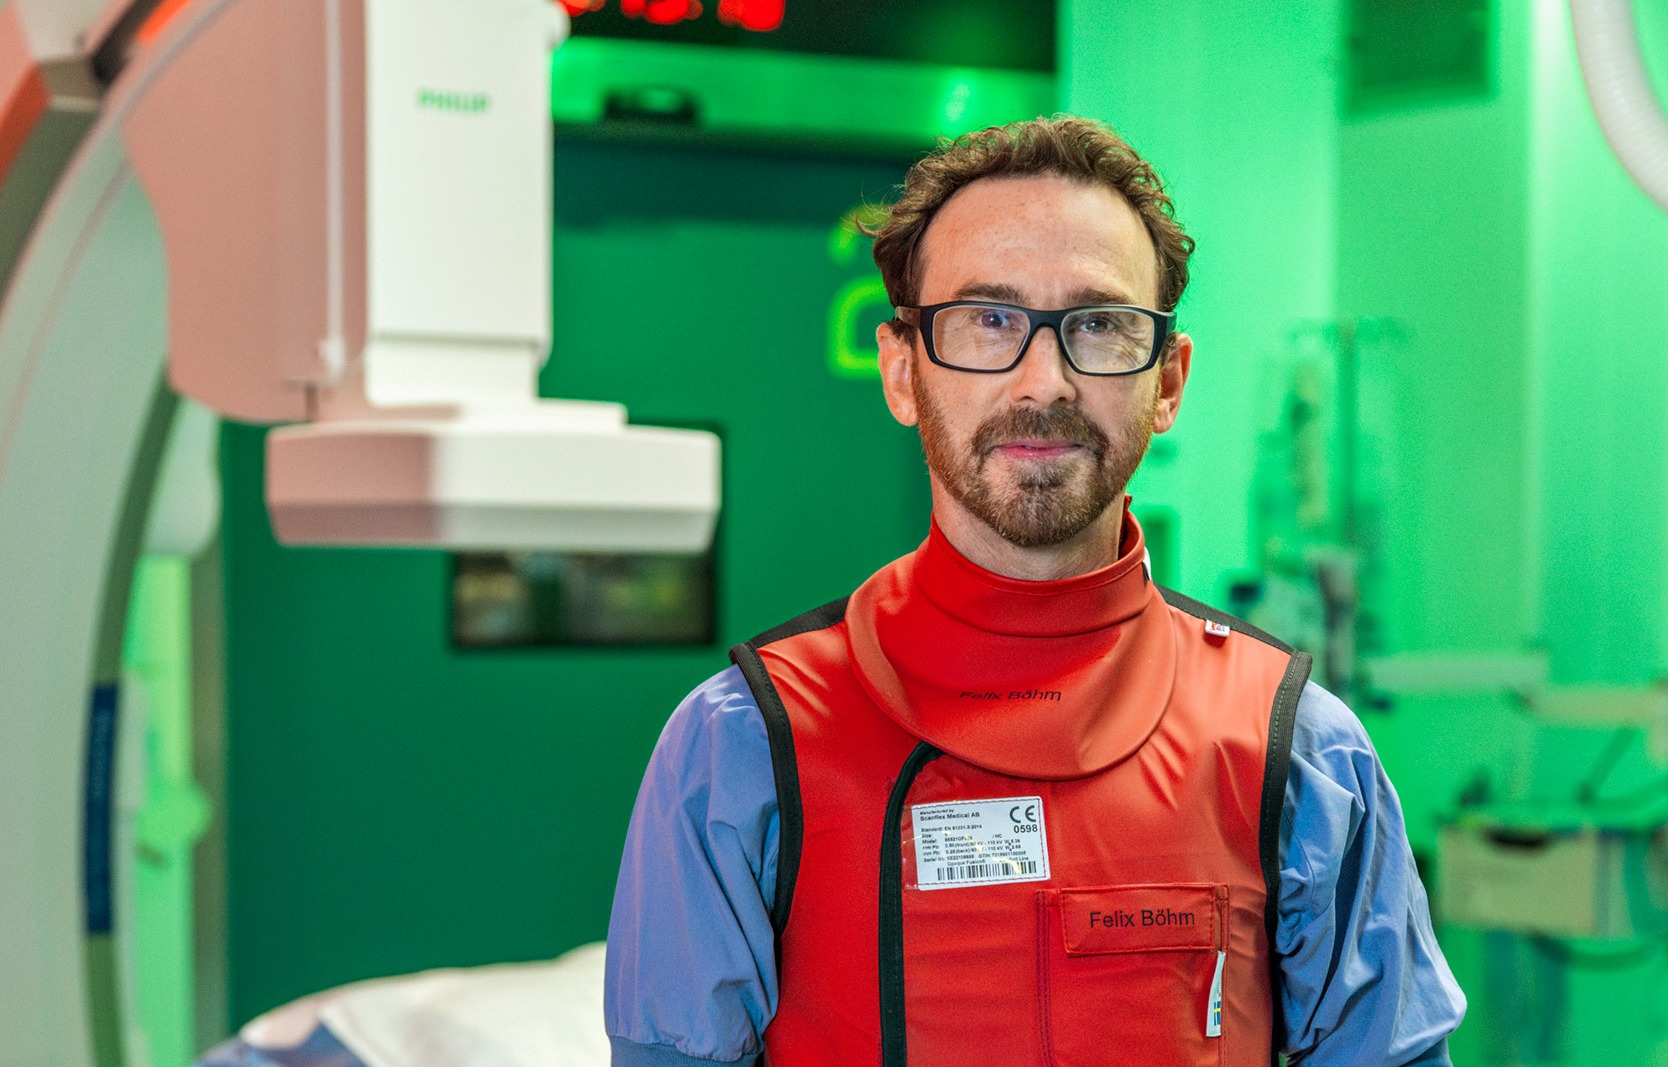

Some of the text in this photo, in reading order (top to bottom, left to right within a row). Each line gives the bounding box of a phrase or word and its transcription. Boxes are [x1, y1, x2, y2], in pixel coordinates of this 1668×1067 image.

[960, 689, 1062, 701] Felix Böhm
[1013, 824, 1038, 834] 0598
[1090, 908, 1195, 928] Felix Böhm
